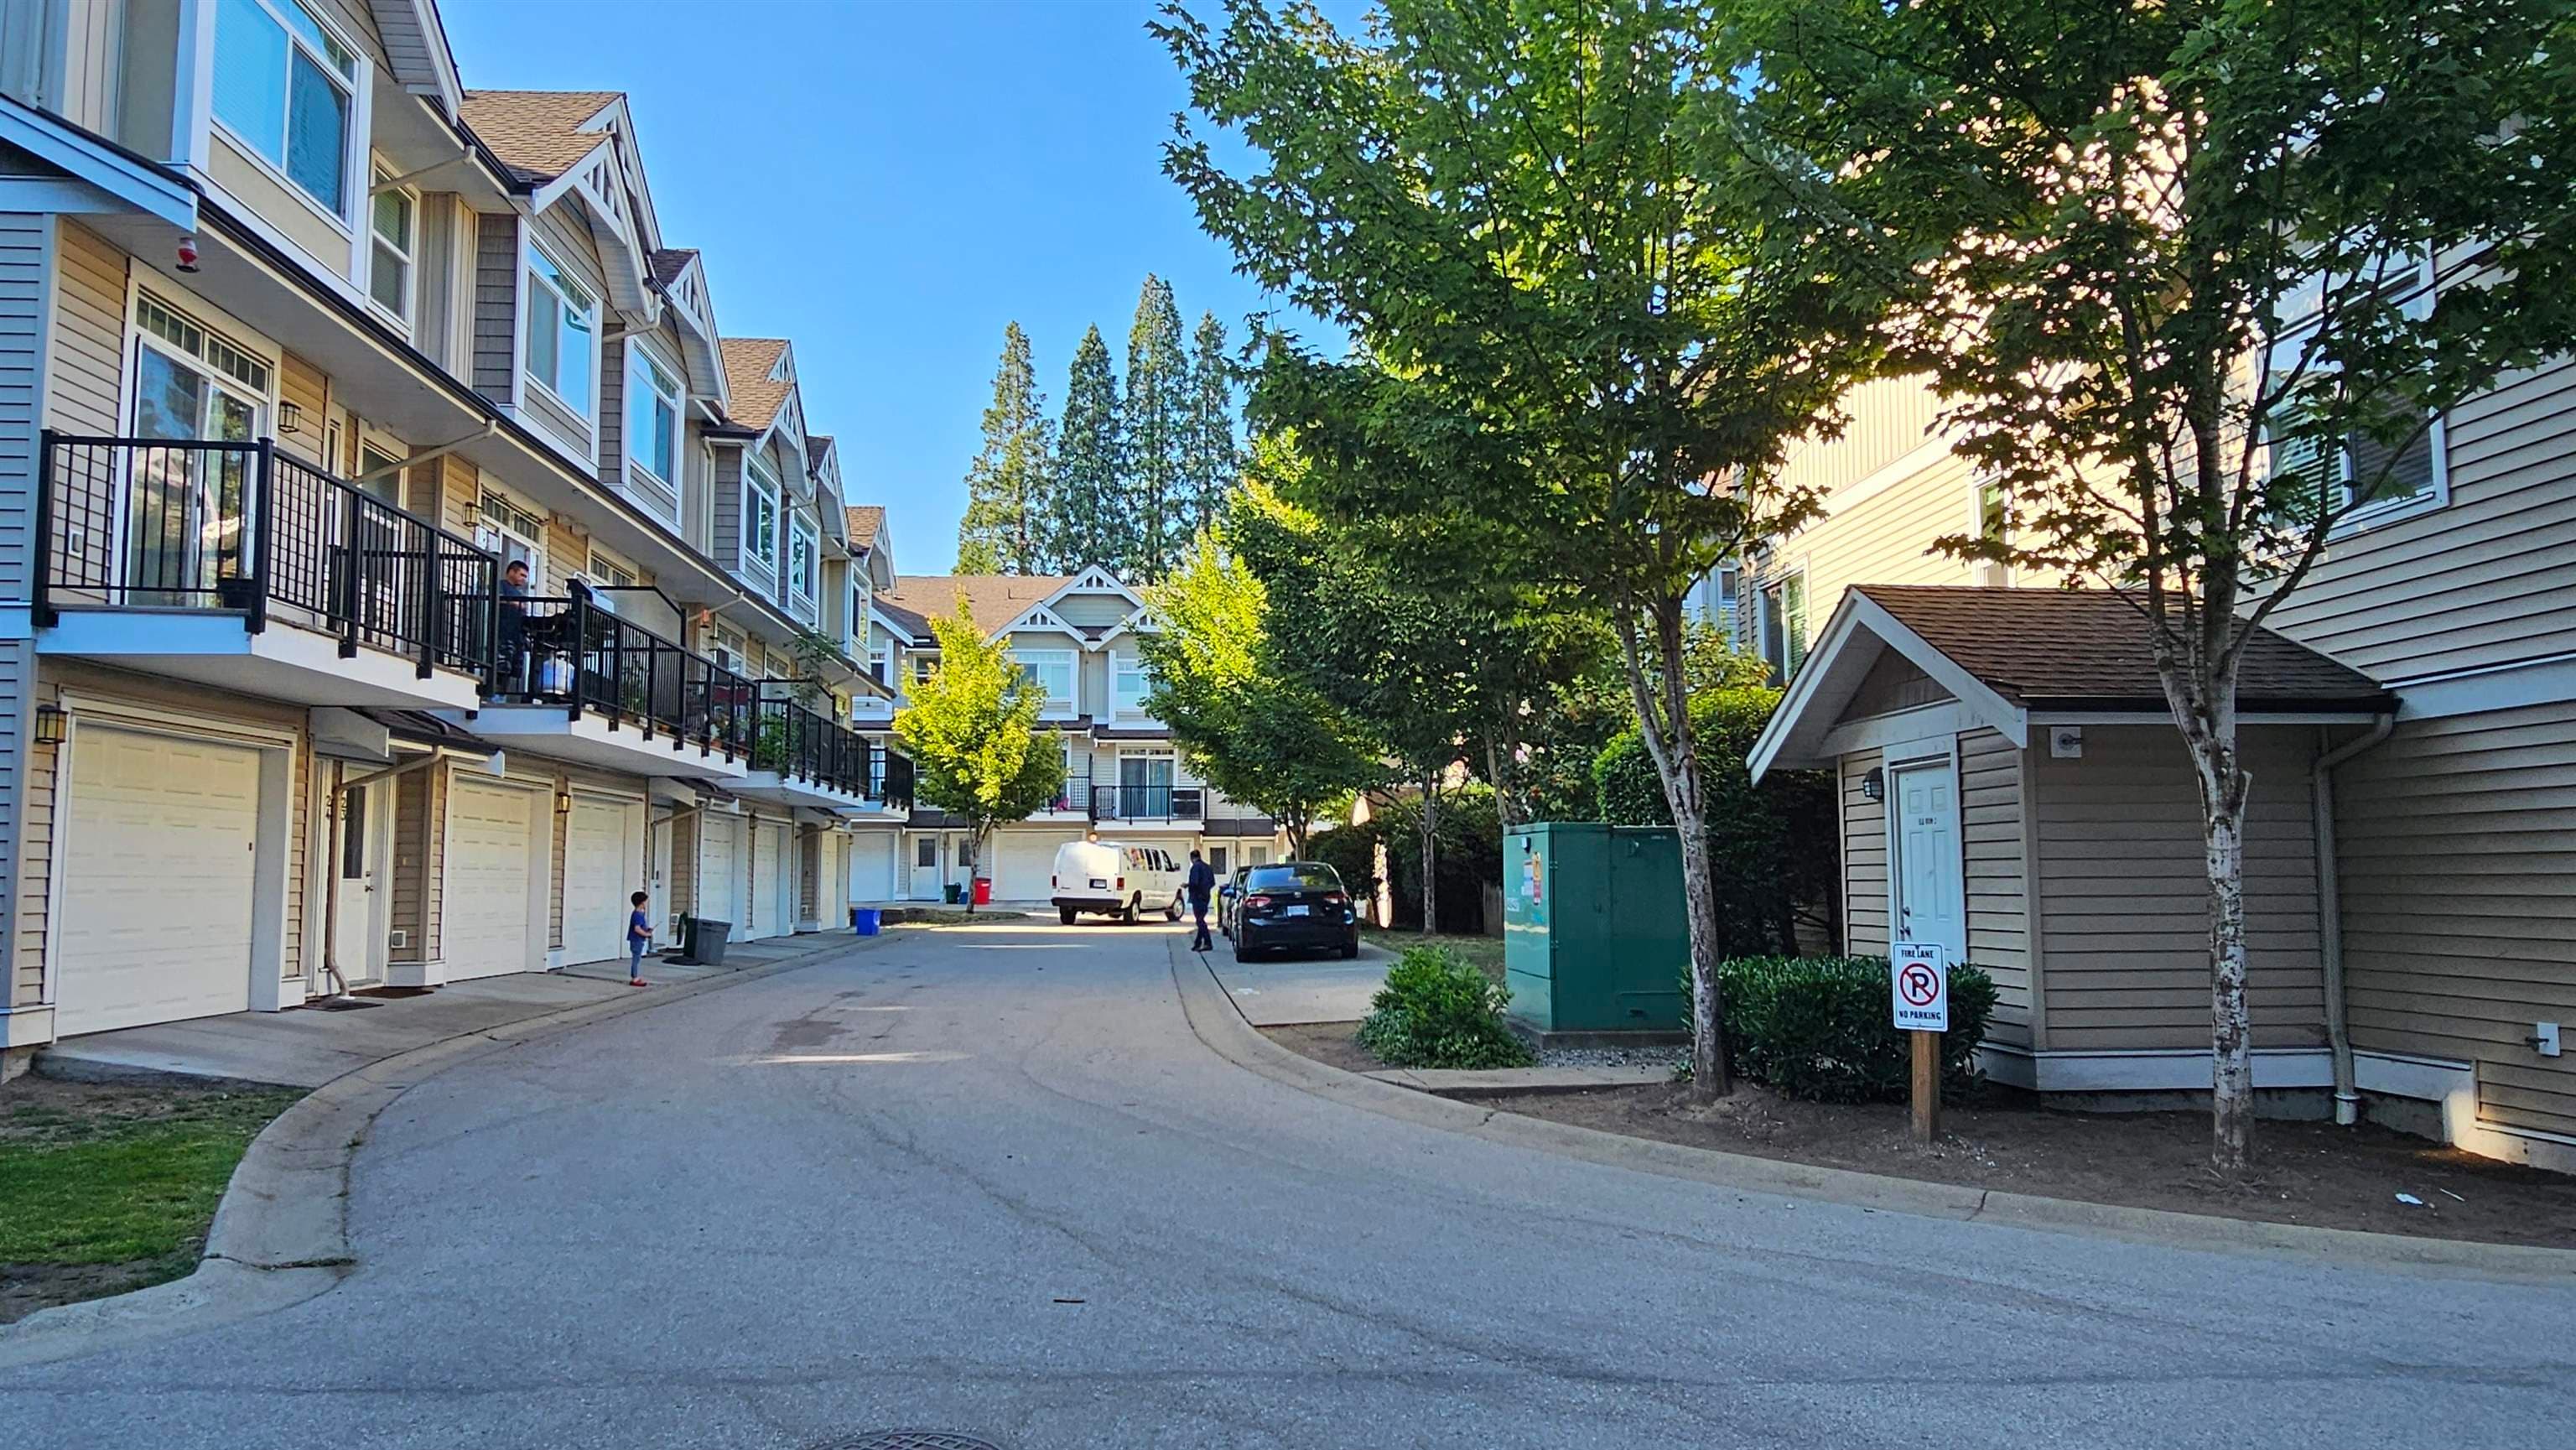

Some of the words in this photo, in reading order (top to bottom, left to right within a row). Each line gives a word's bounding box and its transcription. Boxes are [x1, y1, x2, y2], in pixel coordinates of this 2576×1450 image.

[1901, 949, 1915, 958] FIRE
[1917, 949, 1934, 959] LANE
[1911, 973, 1929, 997] P
[1898, 1010, 1909, 1019] NO
[1910, 1011, 1941, 1021] PARKING
